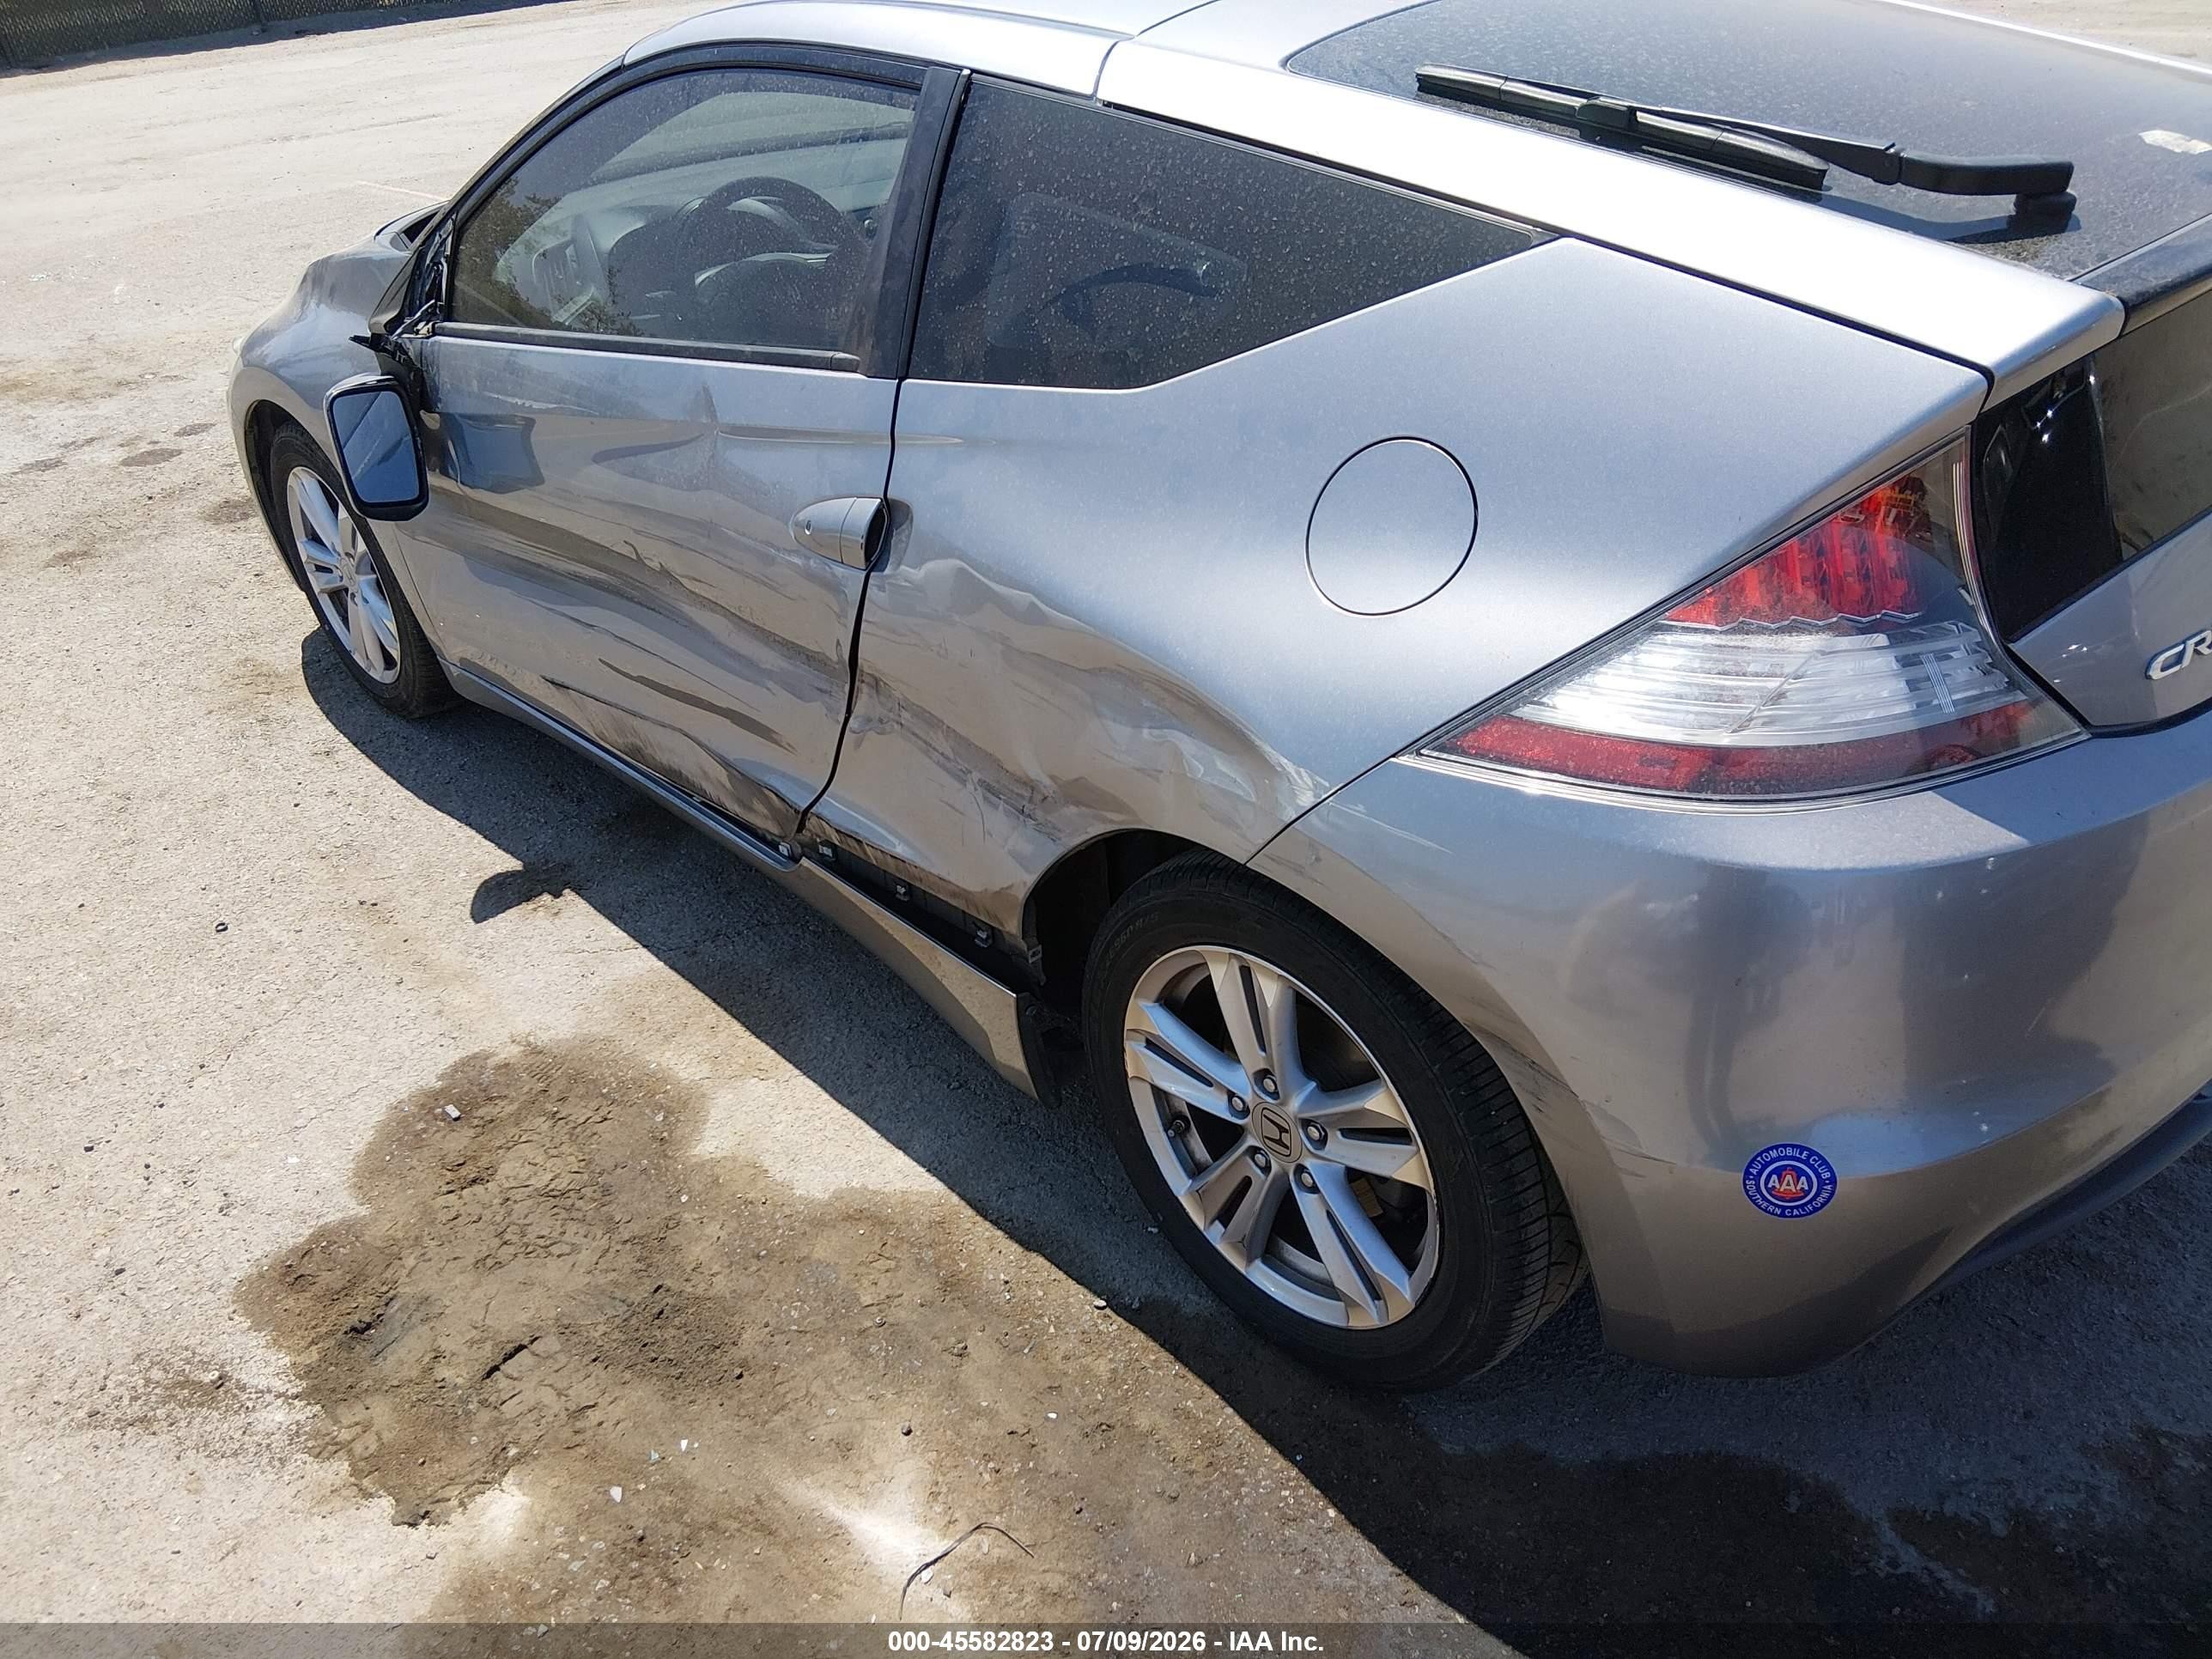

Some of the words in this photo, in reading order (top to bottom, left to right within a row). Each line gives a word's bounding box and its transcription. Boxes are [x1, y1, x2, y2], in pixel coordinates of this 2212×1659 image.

[1750, 1146, 1809, 1176] AUTOMOBILE
[1809, 1155, 1832, 1180] CLUB
[1746, 1179, 1782, 1216] SOUTHERN
[1785, 1184, 1833, 1217] CALIFORNIA
[1767, 1174, 1809, 1193] AAA
